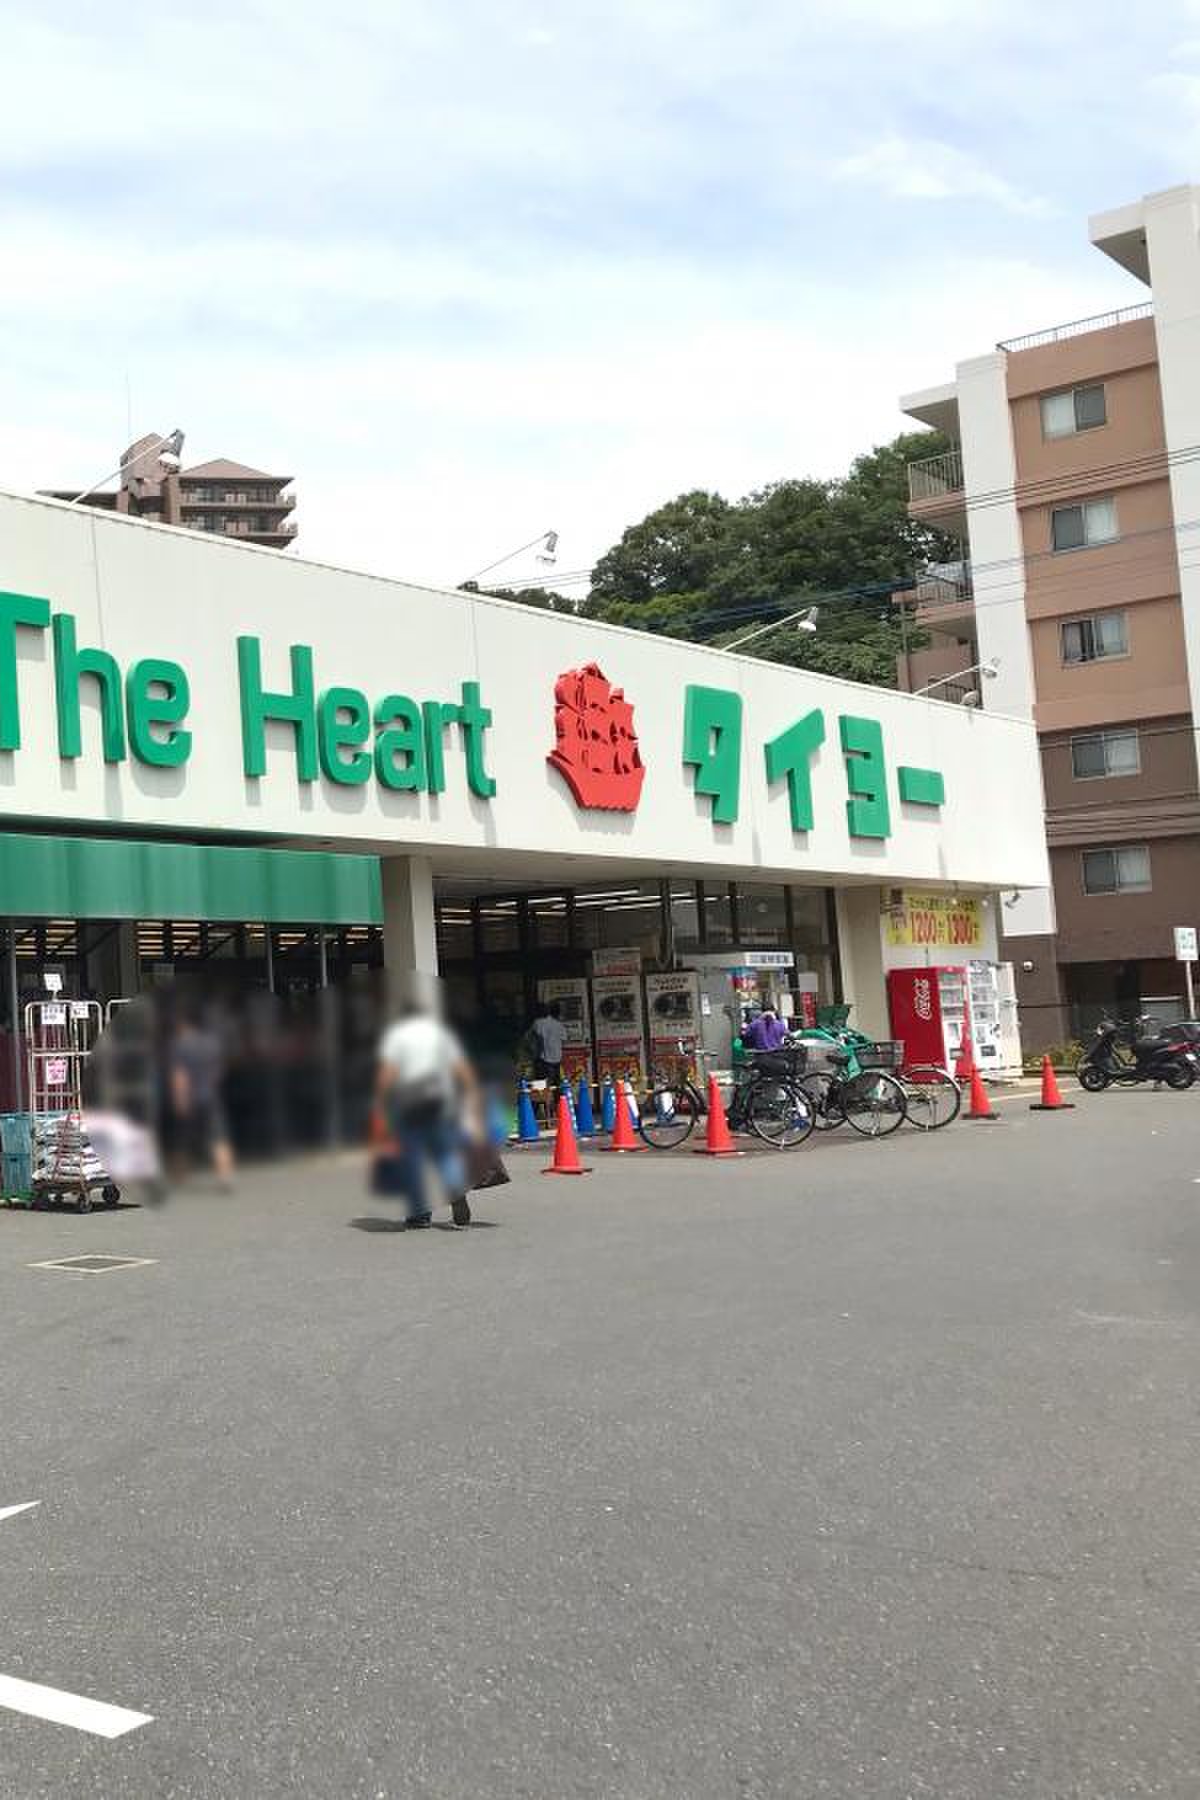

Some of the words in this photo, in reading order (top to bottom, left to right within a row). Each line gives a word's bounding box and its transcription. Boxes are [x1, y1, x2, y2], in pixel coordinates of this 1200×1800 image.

[237, 636, 497, 799] Heart
[682, 685, 945, 840] タイヨー
